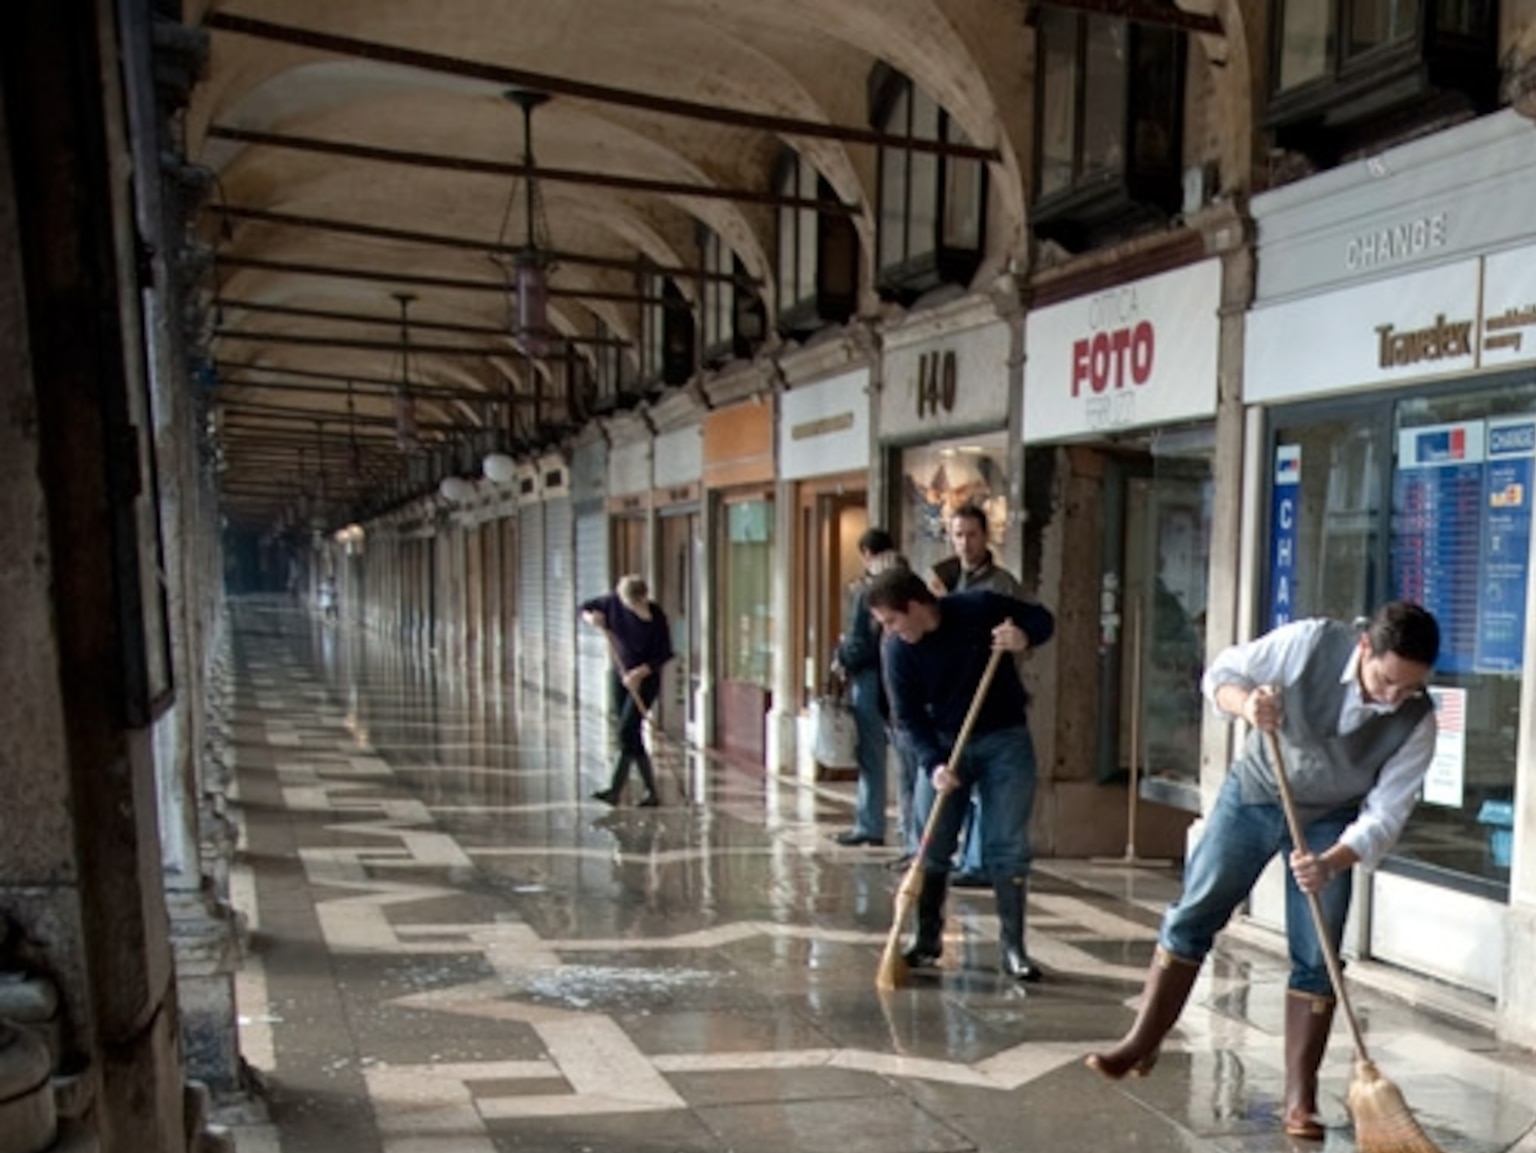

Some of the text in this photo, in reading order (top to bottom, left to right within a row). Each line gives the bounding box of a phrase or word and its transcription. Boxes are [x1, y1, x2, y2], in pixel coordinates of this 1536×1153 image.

[1345, 211, 1447, 270] CHANGE
[917, 350, 956, 419] 140
[1071, 319, 1155, 398] FOTO
